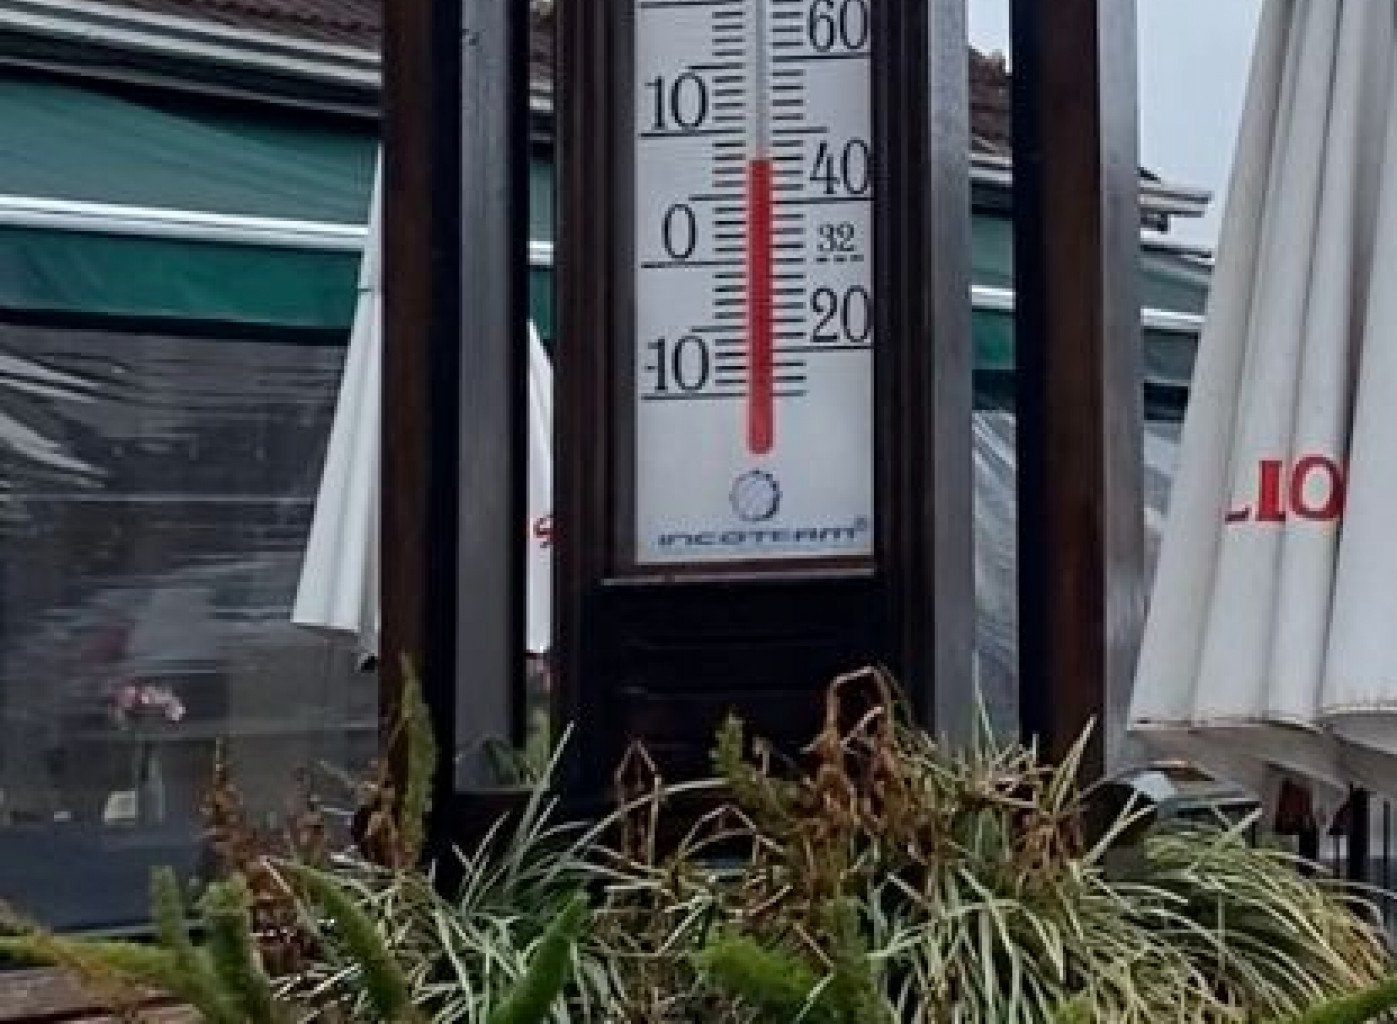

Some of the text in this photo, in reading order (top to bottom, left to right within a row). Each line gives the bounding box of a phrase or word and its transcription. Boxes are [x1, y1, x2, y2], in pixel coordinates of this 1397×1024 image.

[644, 73, 709, 131] 10
[808, 139, 872, 197] 40
[662, 204, 696, 261] 0
[818, 222, 856, 253] 32
[811, 285, 872, 344] 20
